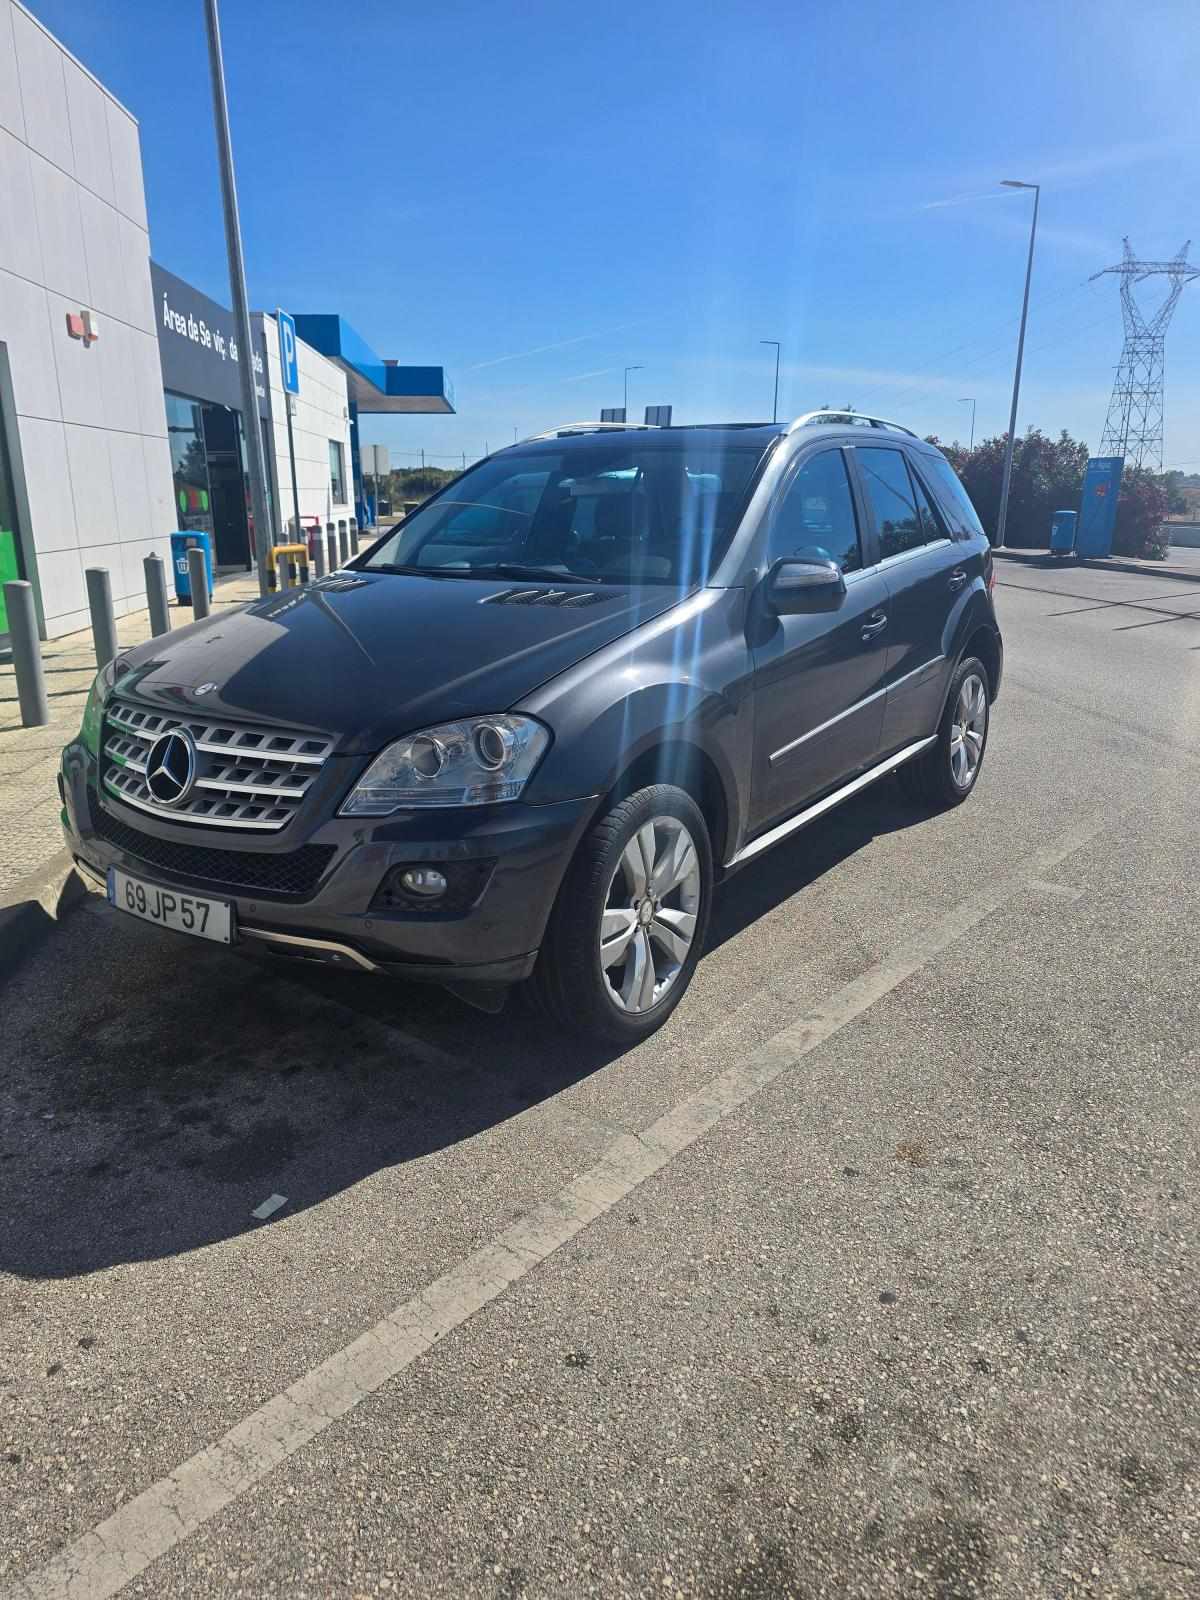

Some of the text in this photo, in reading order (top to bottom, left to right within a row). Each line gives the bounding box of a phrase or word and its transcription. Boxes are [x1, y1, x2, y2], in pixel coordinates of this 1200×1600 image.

[163, 292, 187, 336] Área
[188, 313, 199, 342] de
[283, 320, 294, 384] P
[125, 880, 210, 933] 69 JP 57
